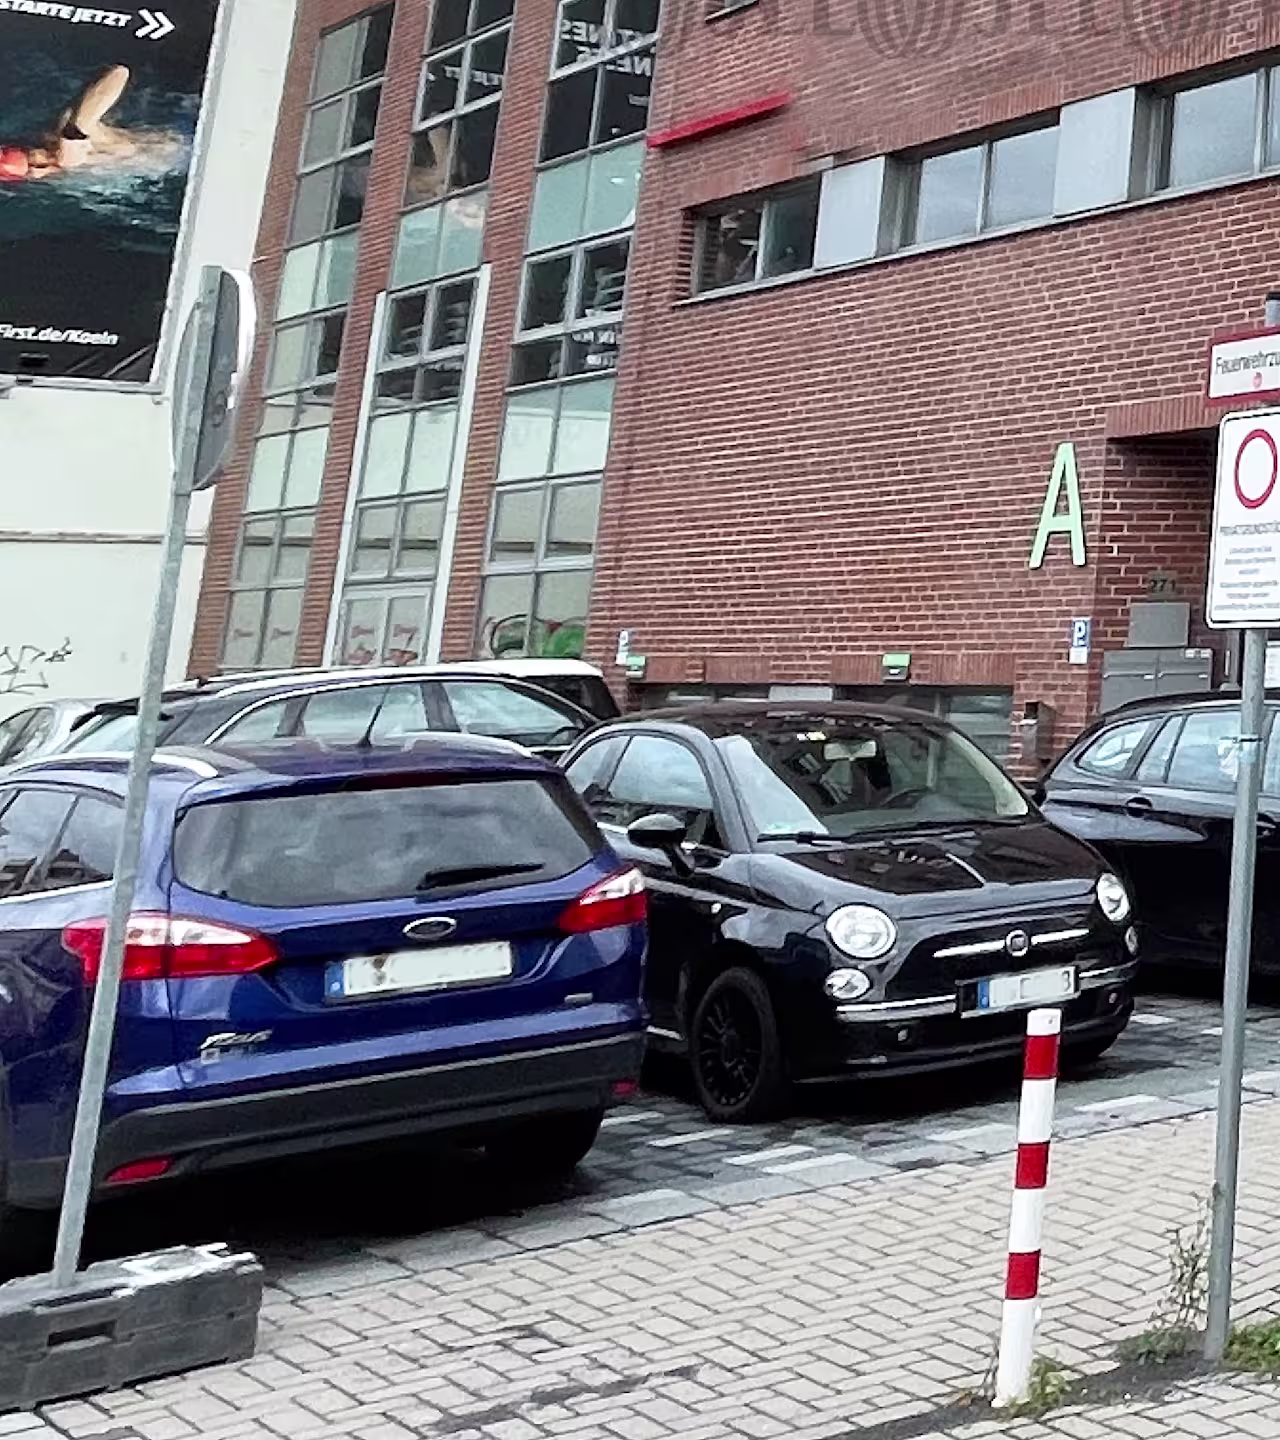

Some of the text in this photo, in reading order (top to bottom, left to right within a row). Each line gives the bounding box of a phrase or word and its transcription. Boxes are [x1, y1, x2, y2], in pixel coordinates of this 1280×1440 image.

[71, 7, 132, 27] JETZT
[1029, 442, 1086, 569] A
[1150, 578, 1177, 593] 271
[1073, 621, 1087, 647] P
